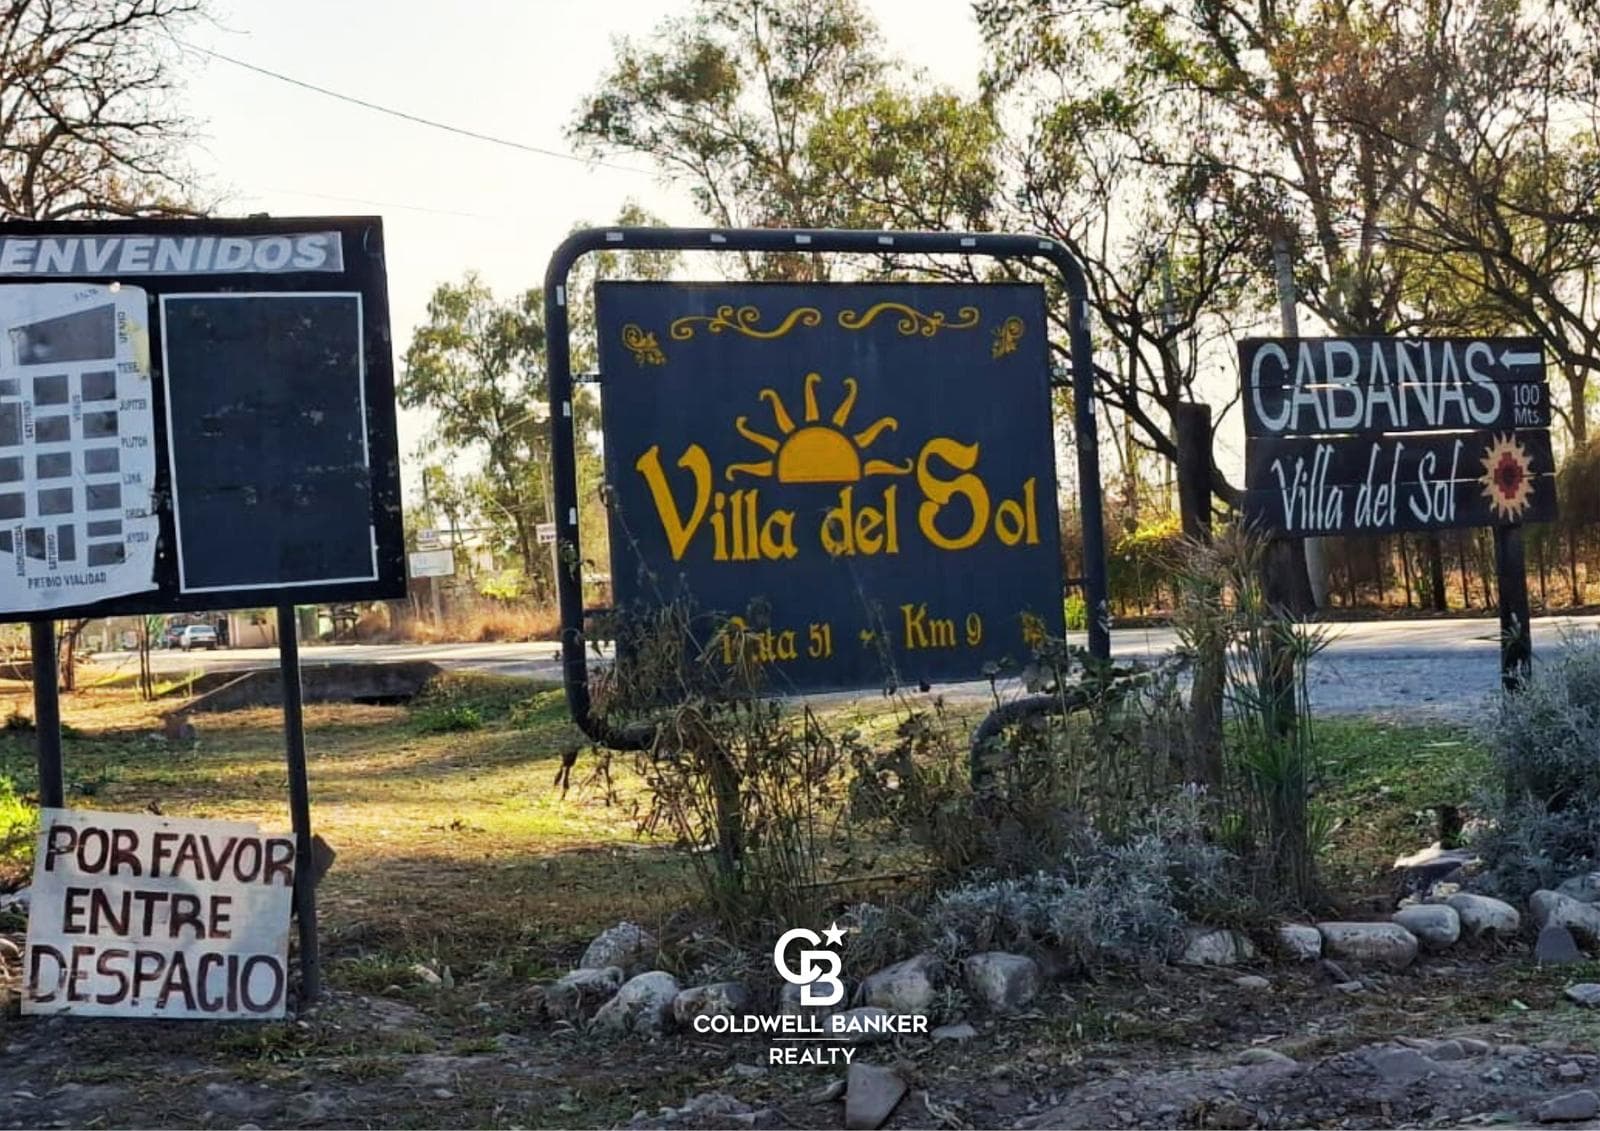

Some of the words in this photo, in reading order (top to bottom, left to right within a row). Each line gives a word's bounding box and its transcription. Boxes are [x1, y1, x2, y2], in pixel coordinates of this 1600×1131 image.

[0, 235, 327, 272] ENVENIDOS
[1251, 339, 1500, 431] CABAÑAS
[1512, 384, 1540, 405] 100
[636, 443, 798, 561] Villa
[820, 484, 899, 556] del
[917, 437, 1040, 550] Sol
[1271, 443, 1343, 530] Villa
[1354, 442, 1404, 528] del
[1409, 439, 1464, 523] Sol
[808, 623, 832, 657] 51
[902, 603, 956, 650] Km
[967, 612, 982, 647] 9
[44, 824, 143, 877] POR
[151, 832, 296, 886] FAVOR
[62, 887, 232, 940] ENTRE
[28, 944, 285, 1013] DESPACIO
